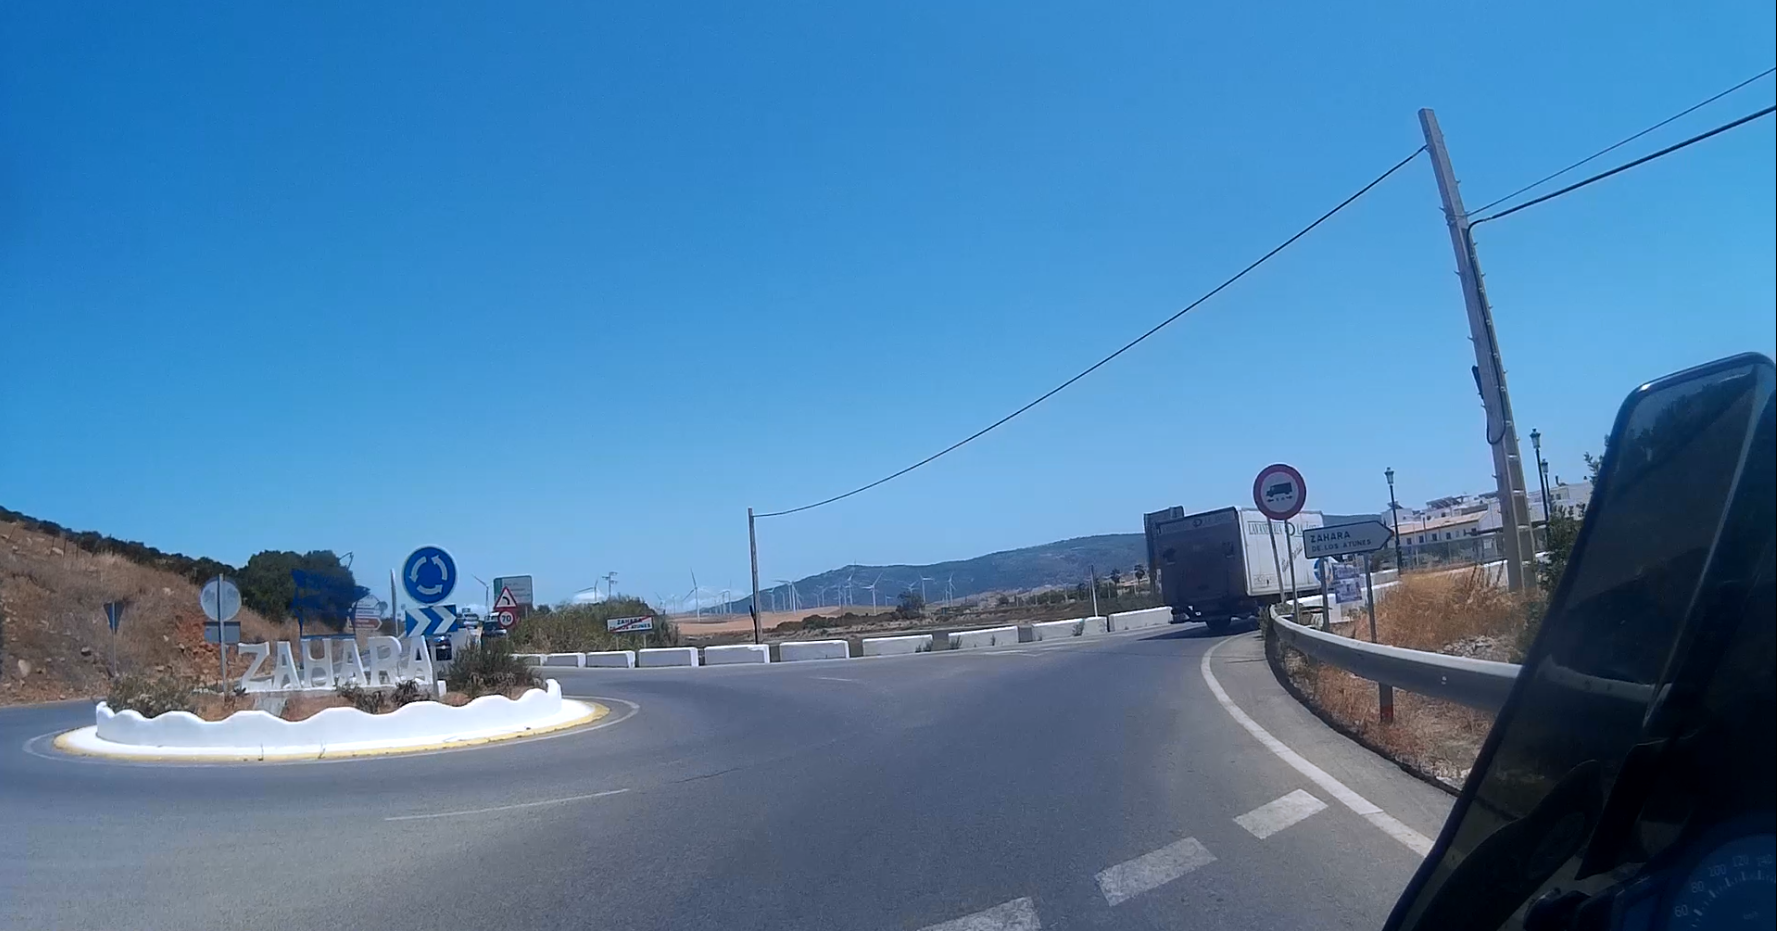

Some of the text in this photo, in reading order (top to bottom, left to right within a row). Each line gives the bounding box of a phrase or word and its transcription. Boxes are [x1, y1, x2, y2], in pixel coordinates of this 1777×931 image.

[1310, 531, 1351, 543] ZAHARA
[1325, 543, 1339, 551] LOS
[1343, 539, 1372, 549] ATUNES
[501, 614, 512, 623] 70
[237, 634, 434, 693] ZAHARA
[1732, 855, 1750, 868] 120
[1709, 864, 1727, 877] 100
[1691, 881, 1704, 893] 80
[1674, 904, 1688, 917] 60
